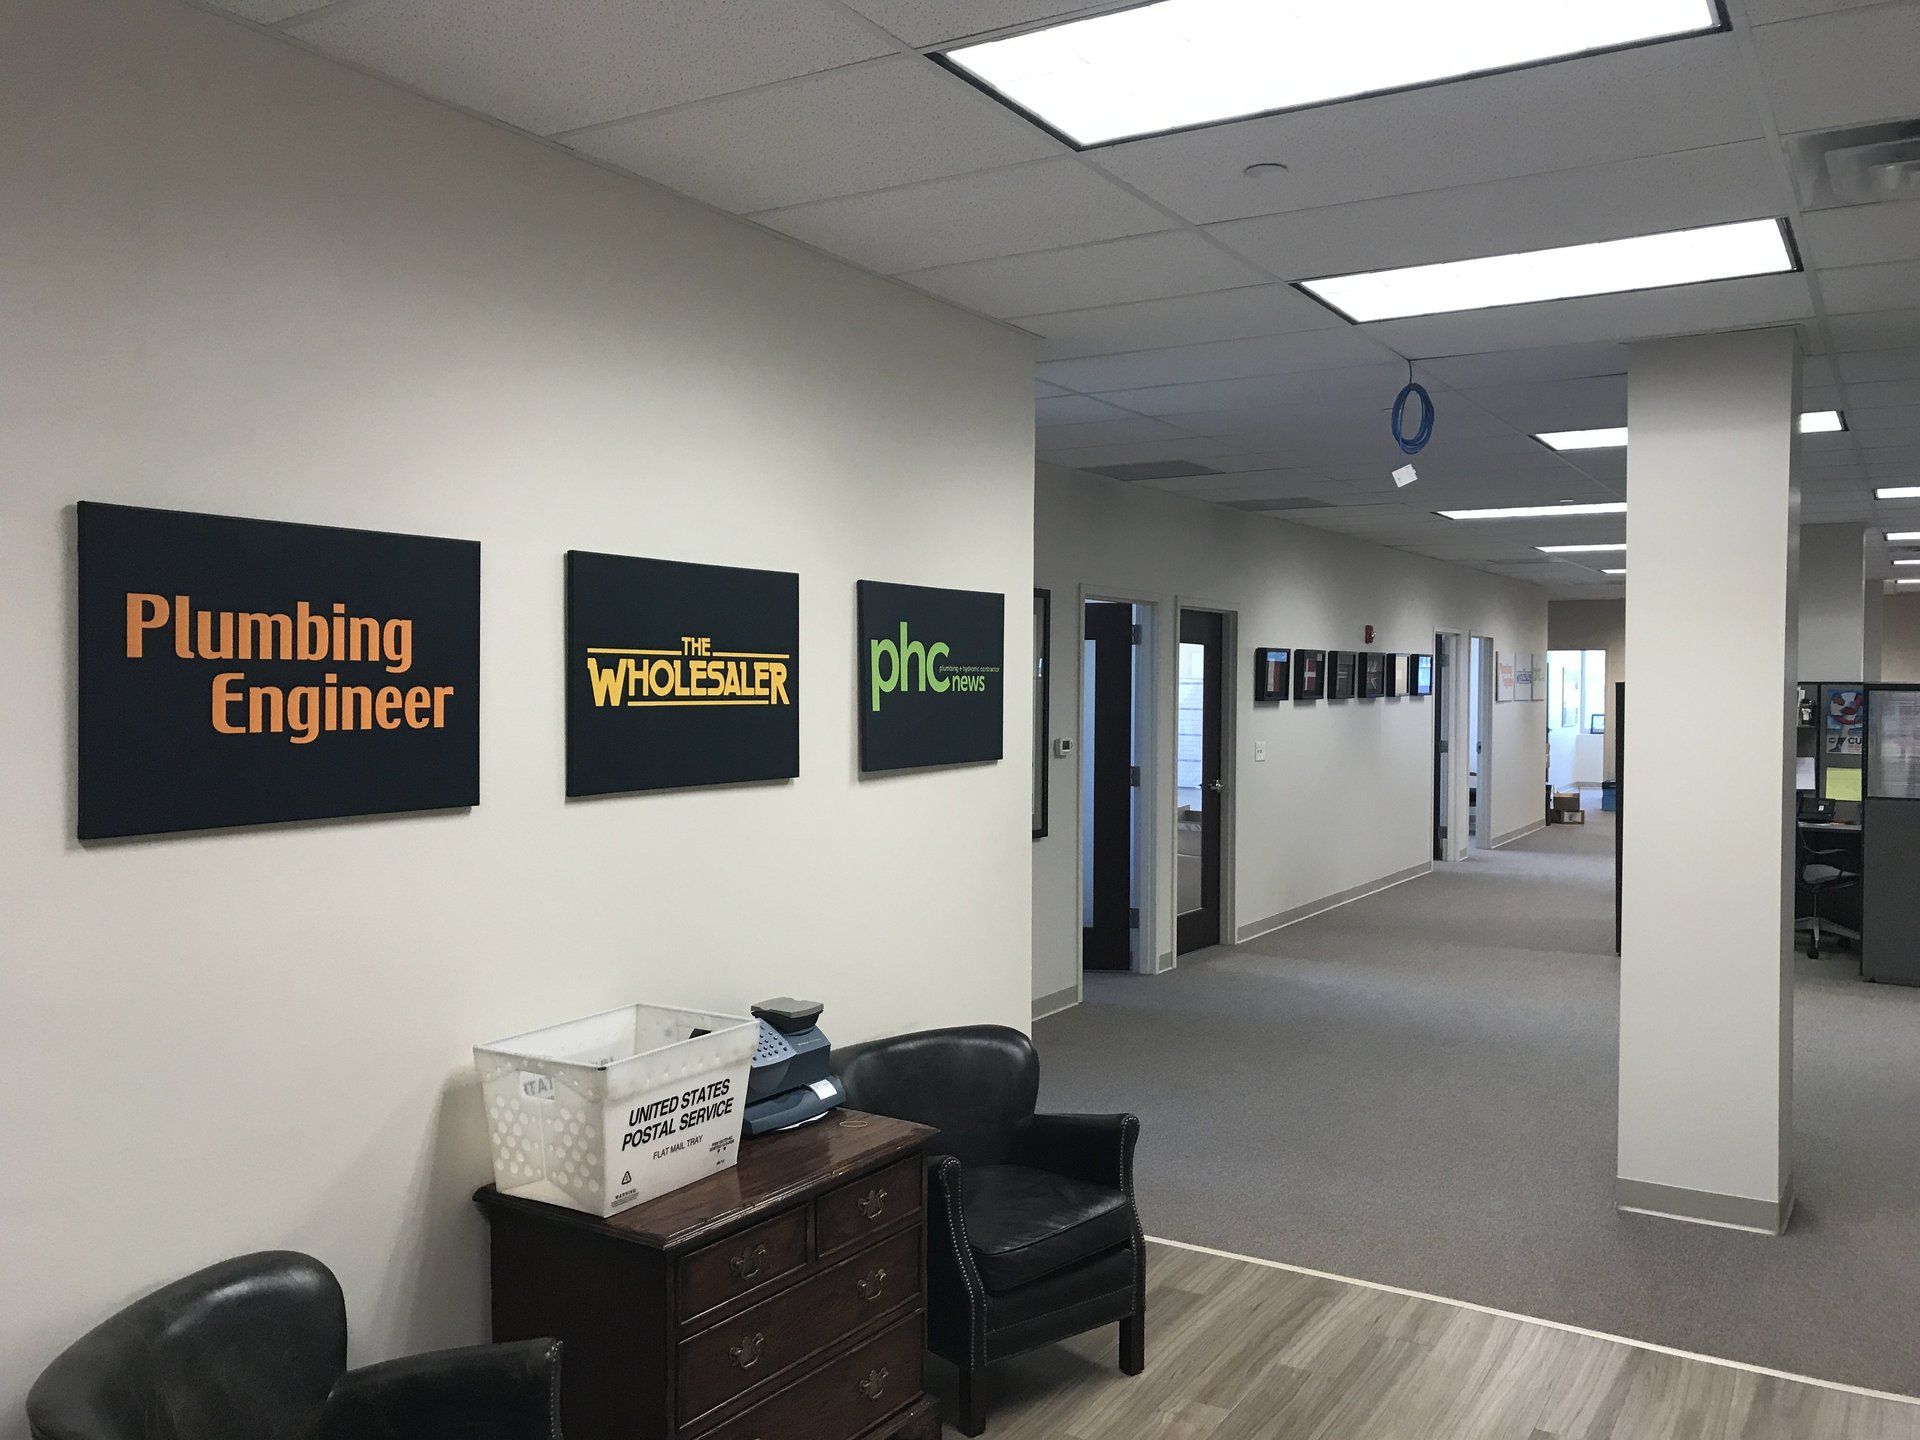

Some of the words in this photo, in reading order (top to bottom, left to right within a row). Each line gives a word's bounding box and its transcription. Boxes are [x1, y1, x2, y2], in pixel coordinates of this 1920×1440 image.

[126, 592, 412, 673] Plumbing
[681, 636, 711, 656] THE
[587, 657, 790, 707] WHOLESALER
[870, 621, 951, 711] phc
[939, 665, 959, 674] plumbing
[952, 674, 985, 692] news
[211, 672, 454, 744] Engineer
[622, 1118, 676, 1151] POSTAL
[679, 1097, 734, 1130] SERVICE
[629, 1096, 679, 1127] UNITED
[681, 1078, 730, 1109] STATES
[653, 1146, 669, 1160] FLAT
[670, 1142, 685, 1153] MAIL
[687, 1135, 703, 1147] TRAY
